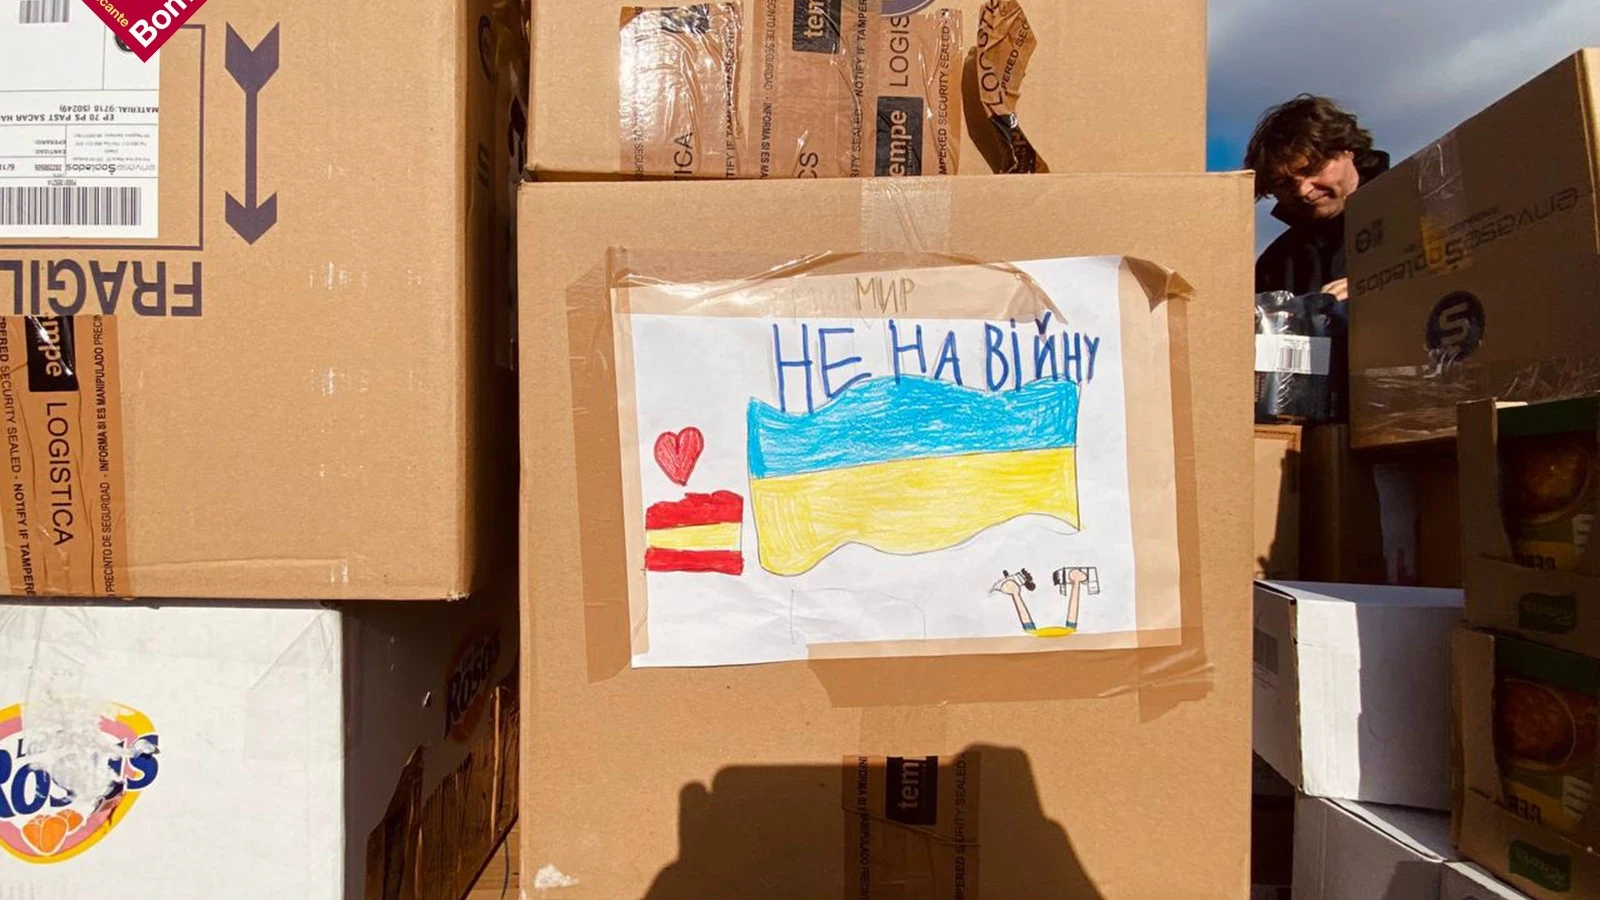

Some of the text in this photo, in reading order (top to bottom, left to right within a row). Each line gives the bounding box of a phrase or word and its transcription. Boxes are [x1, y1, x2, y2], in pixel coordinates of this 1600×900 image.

[852, 58, 864, 96] NOTIFY
[938, 70, 950, 126] SECURITY
[59, 105, 90, 113] (50249)
[94, 105, 115, 113] 9718
[94, 347, 106, 406] MANIPULADO
[773, 323, 872, 413] НЕ
[888, 319, 964, 386] НА
[0, 366, 16, 422] SECURITY
[97, 407, 107, 420] ES
[7, 427, 21, 473] SEALED
[97, 432, 110, 472] INFORMA
[46, 402, 74, 546] LOGISTICA
[13, 483, 28, 527] NOTIFY
[100, 482, 112, 533] SEGURIDAD
[18, 529, 29, 540] IF
[102, 538, 112, 548] DE
[102, 549, 116, 593] PRECINTO
